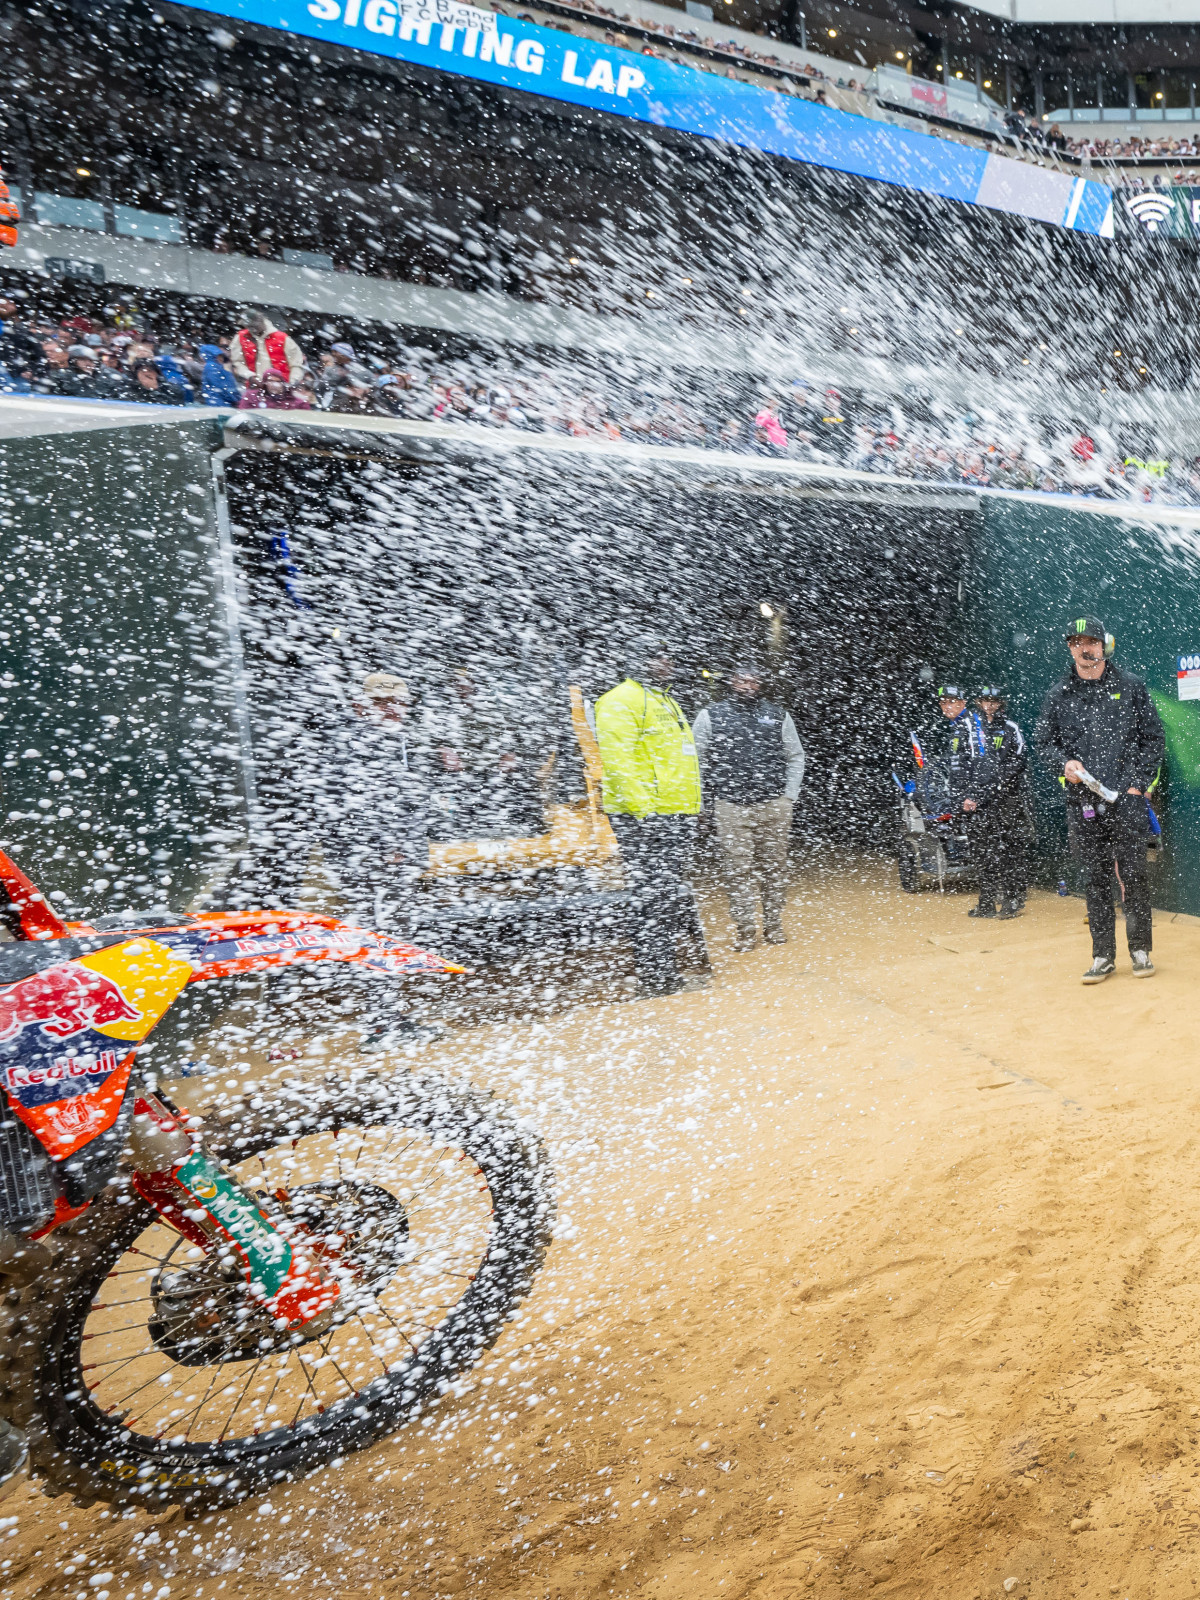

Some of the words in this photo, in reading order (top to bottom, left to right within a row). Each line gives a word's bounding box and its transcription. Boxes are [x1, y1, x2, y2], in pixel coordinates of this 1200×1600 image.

[436, 12, 492, 32] Webb
[457, 9, 494, 24] and
[306, 0, 546, 75] SIGHTING
[561, 50, 646, 98] LAP
